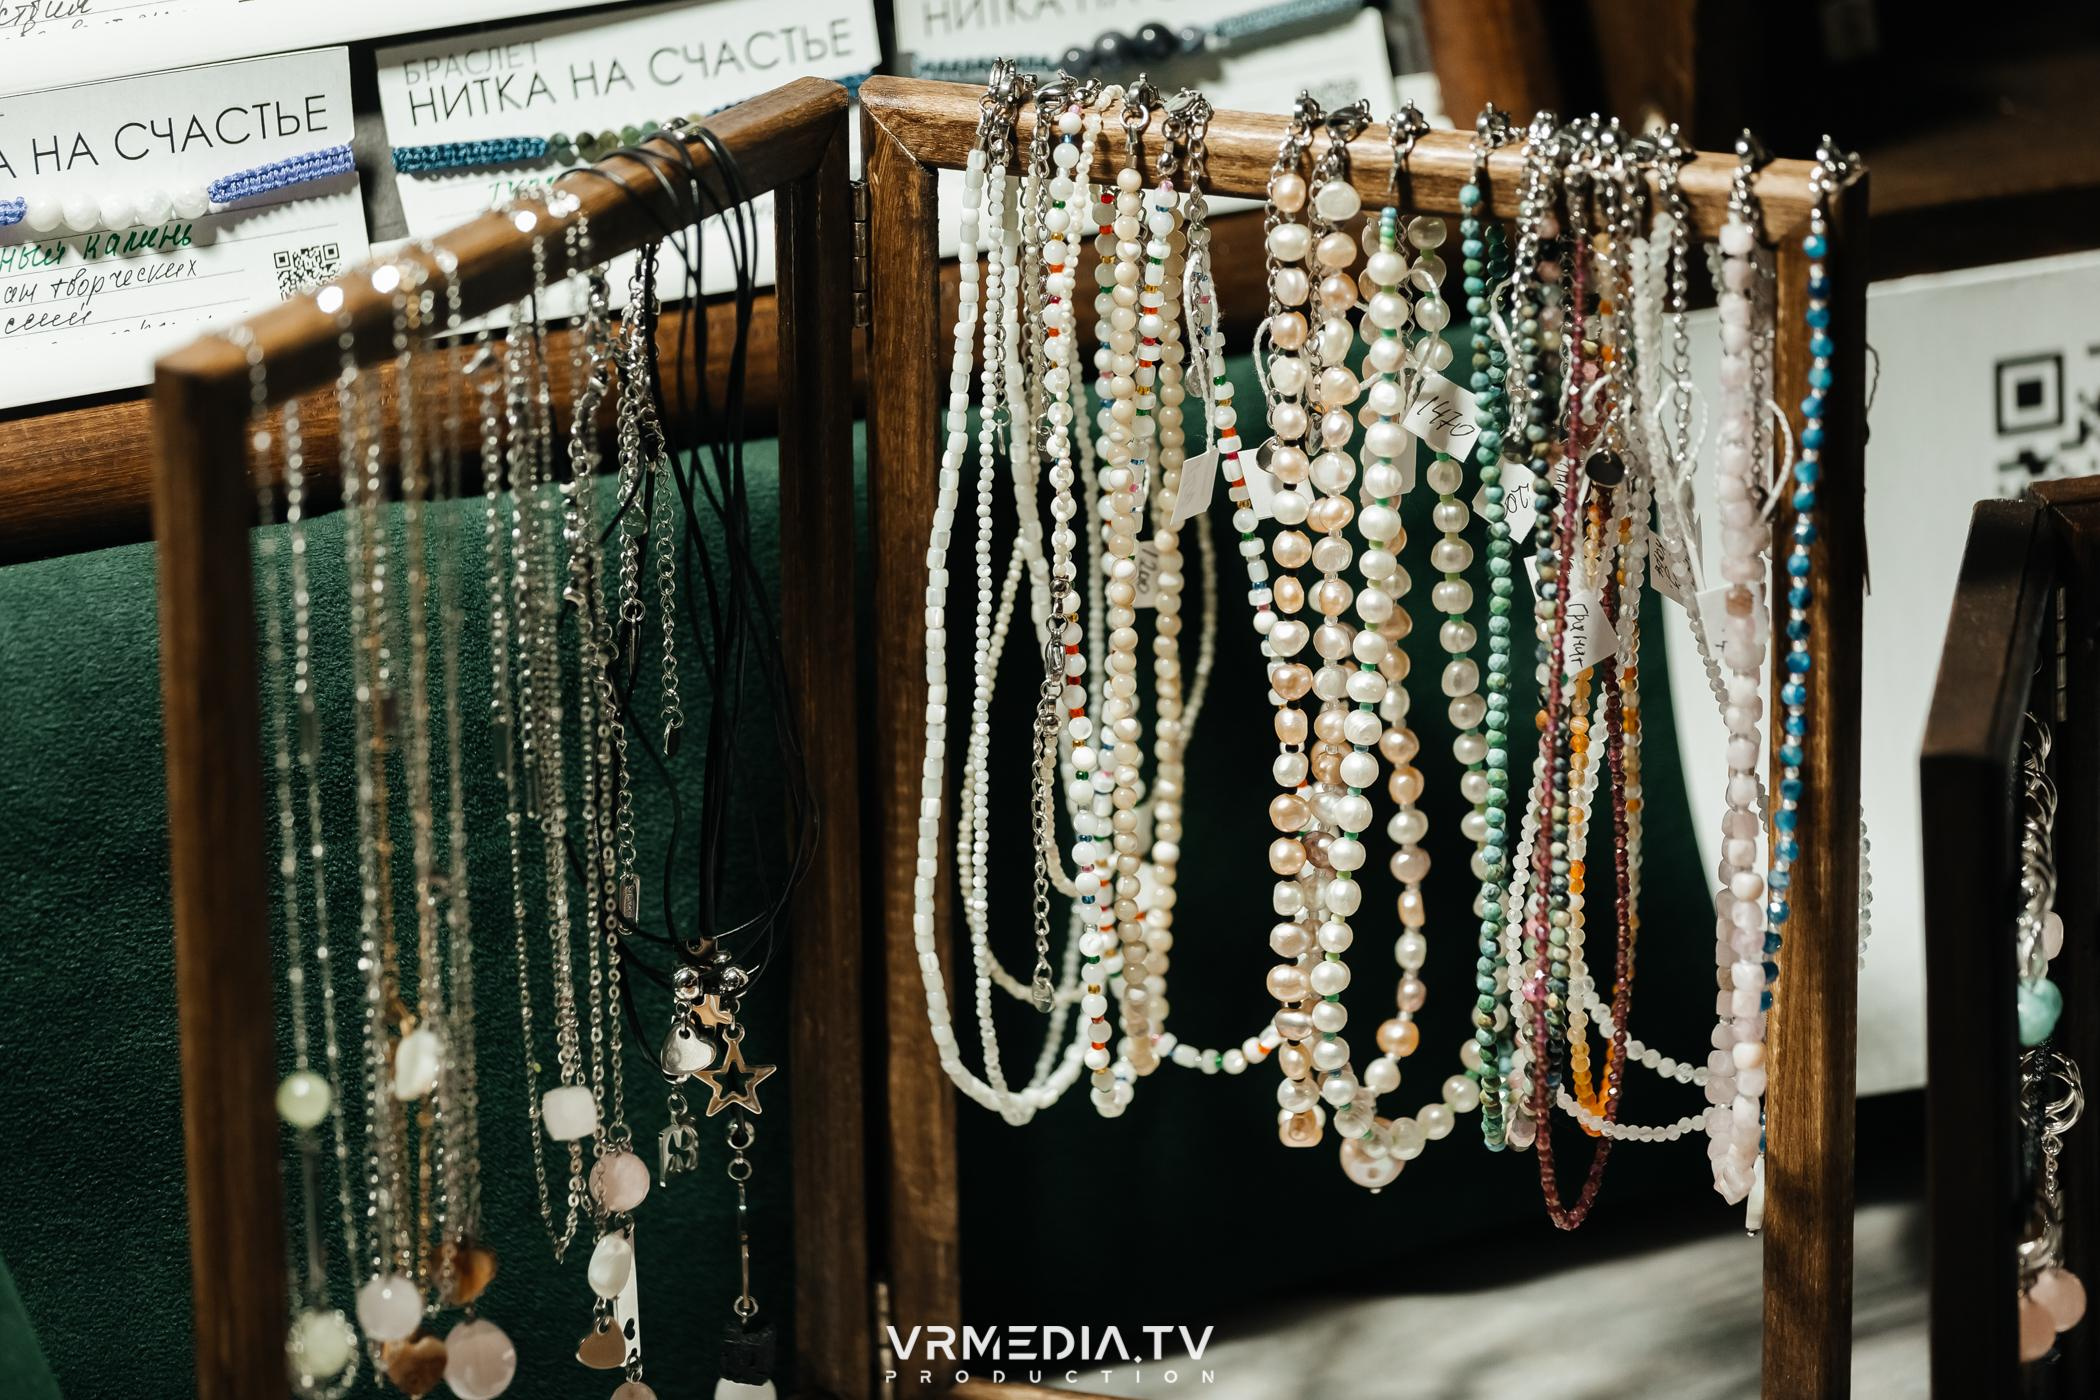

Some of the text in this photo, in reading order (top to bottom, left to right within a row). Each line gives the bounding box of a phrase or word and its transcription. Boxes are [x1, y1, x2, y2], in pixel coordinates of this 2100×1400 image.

[403, 38, 542, 86] БРАСЛЕТ
[409, 18, 854, 126] НИТКА НА СЧАСТЬЕ
[32, 132, 99, 175] НА
[115, 95, 328, 161] СЧАСТЬЕ
[51, 259, 198, 306] творческих
